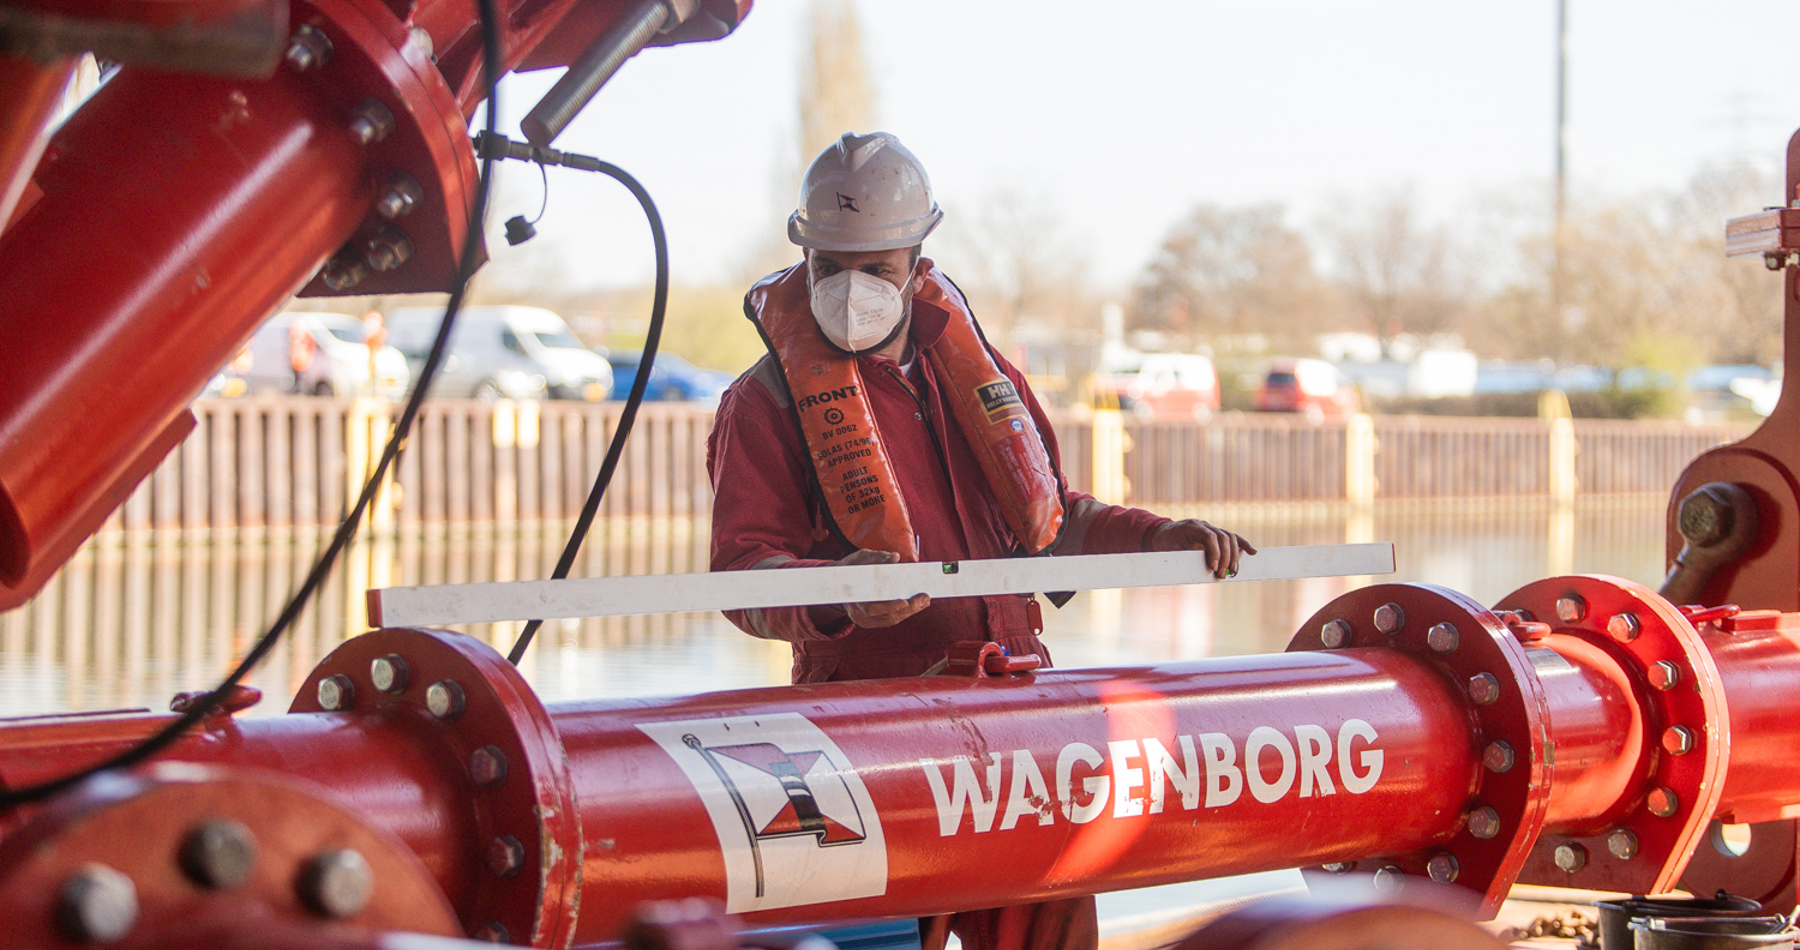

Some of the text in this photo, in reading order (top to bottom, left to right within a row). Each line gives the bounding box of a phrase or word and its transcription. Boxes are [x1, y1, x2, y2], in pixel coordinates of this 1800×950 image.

[798, 386, 856, 412] FRONT
[987, 383, 1011, 399] HH
[822, 424, 858, 440] BV 0062
[817, 444, 843, 460] SOLAS
[827, 449, 872, 468] APPROVED
[842, 466, 868, 481] ADULT
[840, 475, 879, 493] PERSONS
[845, 486, 881, 503] OF 32kg
[848, 494, 887, 515] OR MORE
[920, 718, 1385, 837] WAGENBORG
